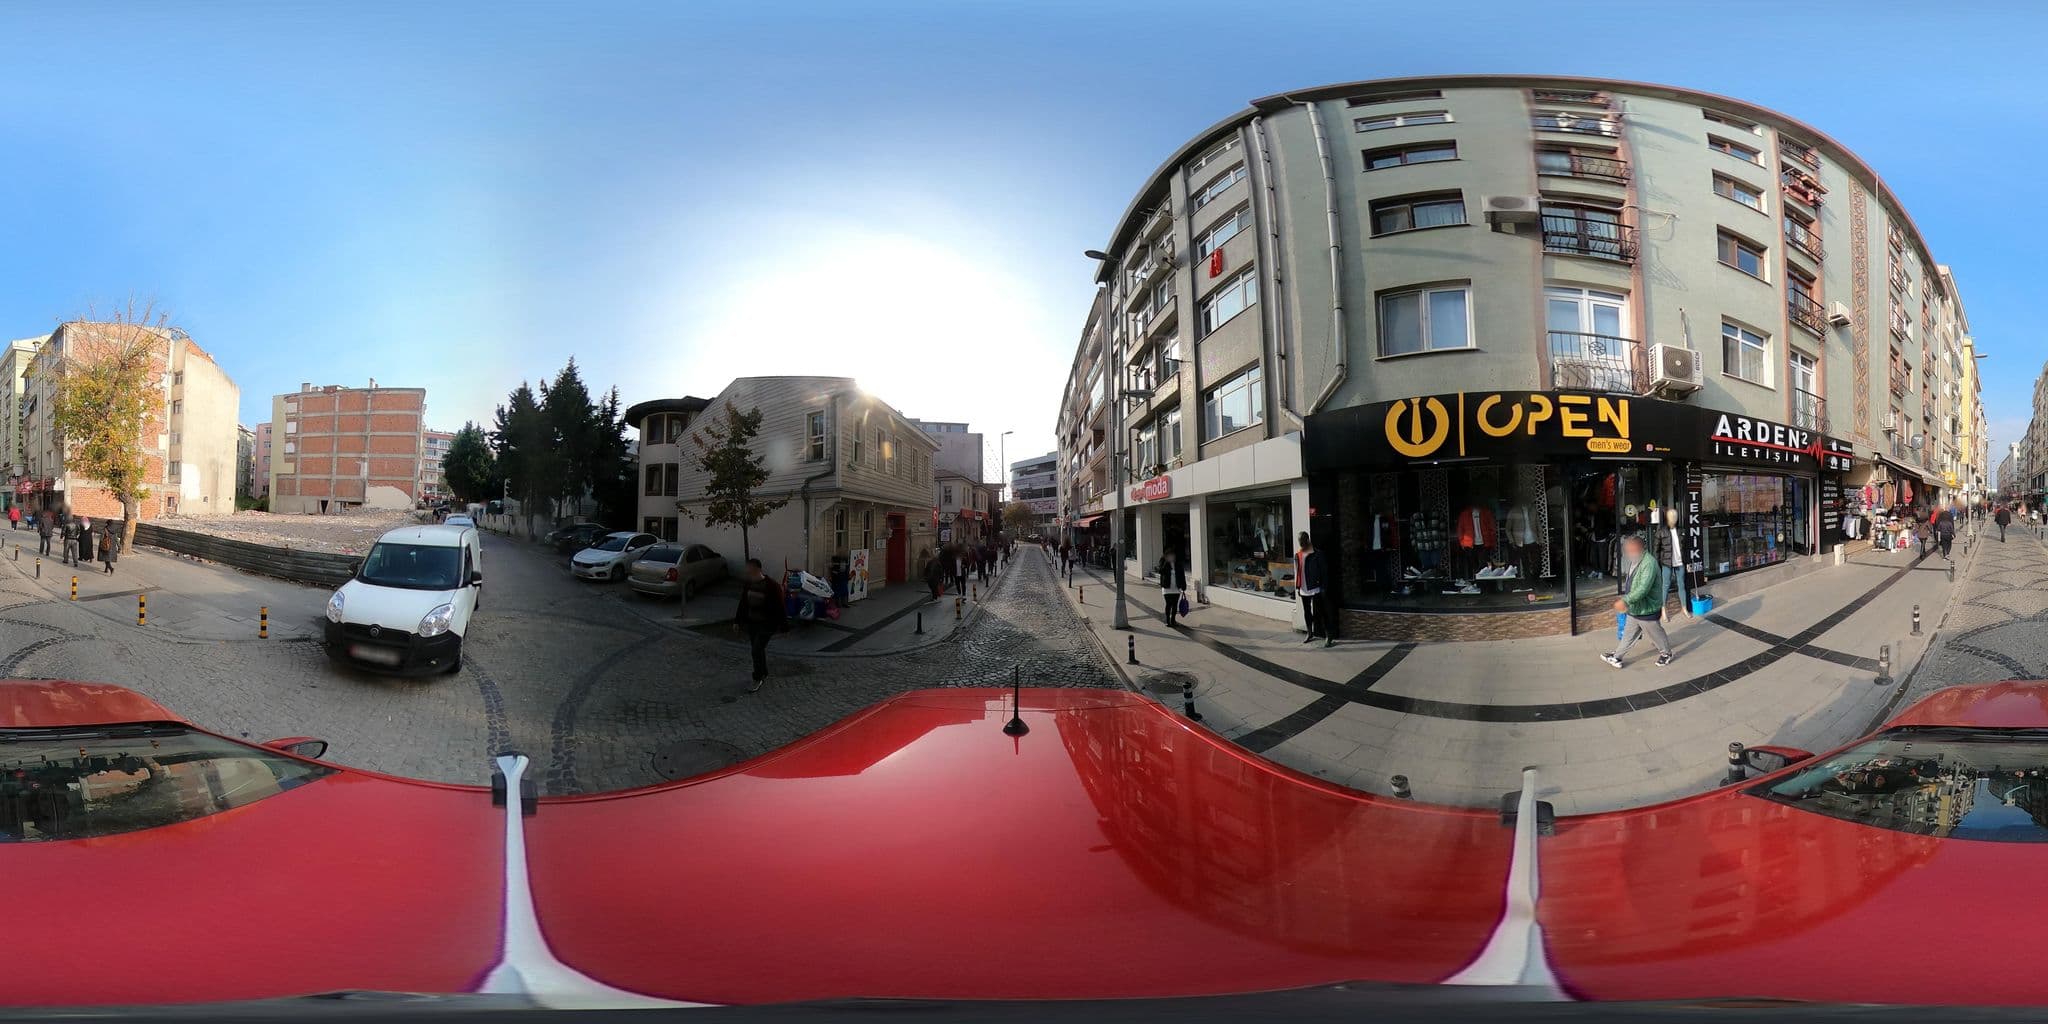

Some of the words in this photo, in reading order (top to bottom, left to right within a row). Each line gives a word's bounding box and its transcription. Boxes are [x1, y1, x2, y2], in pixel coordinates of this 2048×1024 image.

[1477, 393, 1629, 438] OPEN
[1591, 440, 1612, 450] men's
[1613, 442, 1630, 450] wear
[1715, 442, 1800, 463] İLETİŞİM
[1146, 478, 1167, 497] moda
[1689, 491, 1701, 560] TEKNİK
